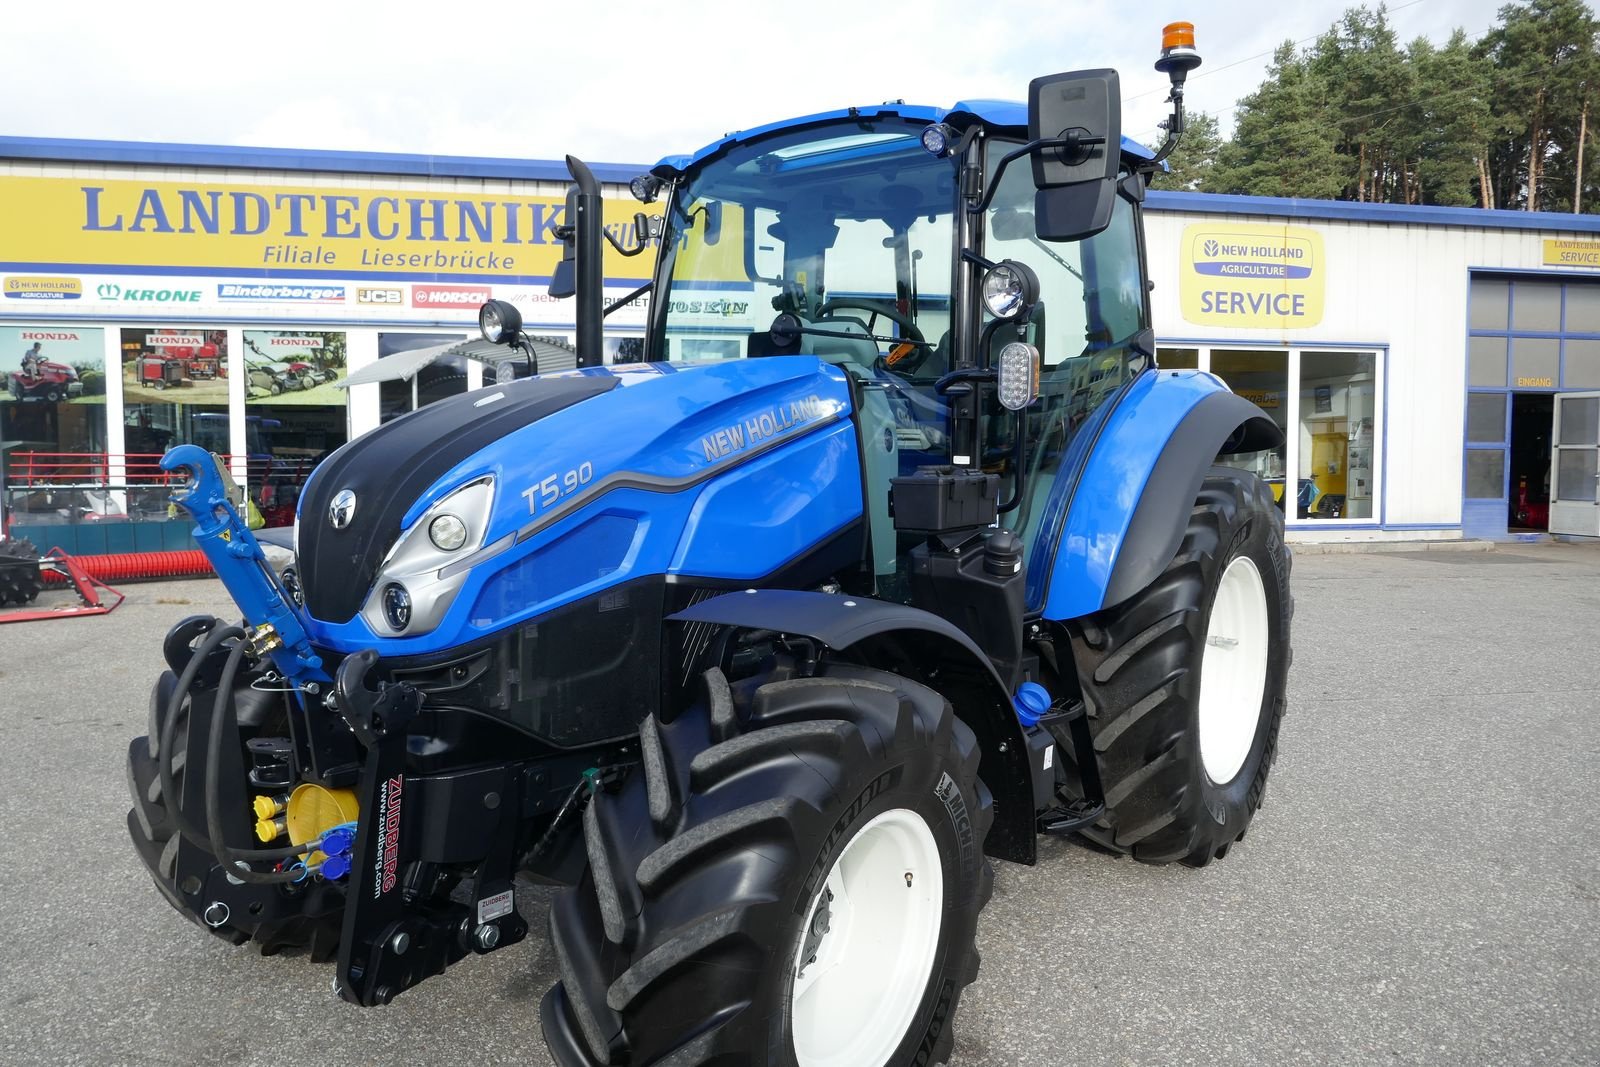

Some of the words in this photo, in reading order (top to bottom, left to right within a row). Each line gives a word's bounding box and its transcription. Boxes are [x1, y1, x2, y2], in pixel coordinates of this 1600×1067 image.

[81, 187, 566, 246] LANDTECHNIK
[263, 246, 337, 264] Filiale
[361, 248, 515, 269] Lieserbrücke
[1221, 245, 1248, 257] NEW
[1251, 246, 1304, 259] HOLLAND
[1560, 251, 1599, 262] SERVICE
[1220, 264, 1285, 276] AGRICULTURE
[123, 289, 203, 302] KRONE
[221, 284, 343, 300] Binderberger
[358, 290, 402, 303] JCB
[428, 291, 488, 304] HORSCH
[667, 300, 748, 314] JOSKIN
[1201, 290, 1305, 316] SERVICE
[22, 332, 79, 341] HONDA
[150, 337, 201, 345] HONDA
[271, 338, 320, 347] HONDA
[1519, 378, 1552, 387] EINGANG
[701, 423, 745, 462] NEW
[745, 394, 821, 443] HOLLAND
[521, 461, 593, 517] T5.90
[375, 781, 388, 899] www.zuidberg.com
[382, 773, 403, 893] ZUIDBERG
[482, 893, 510, 908] ZUIDBERG
